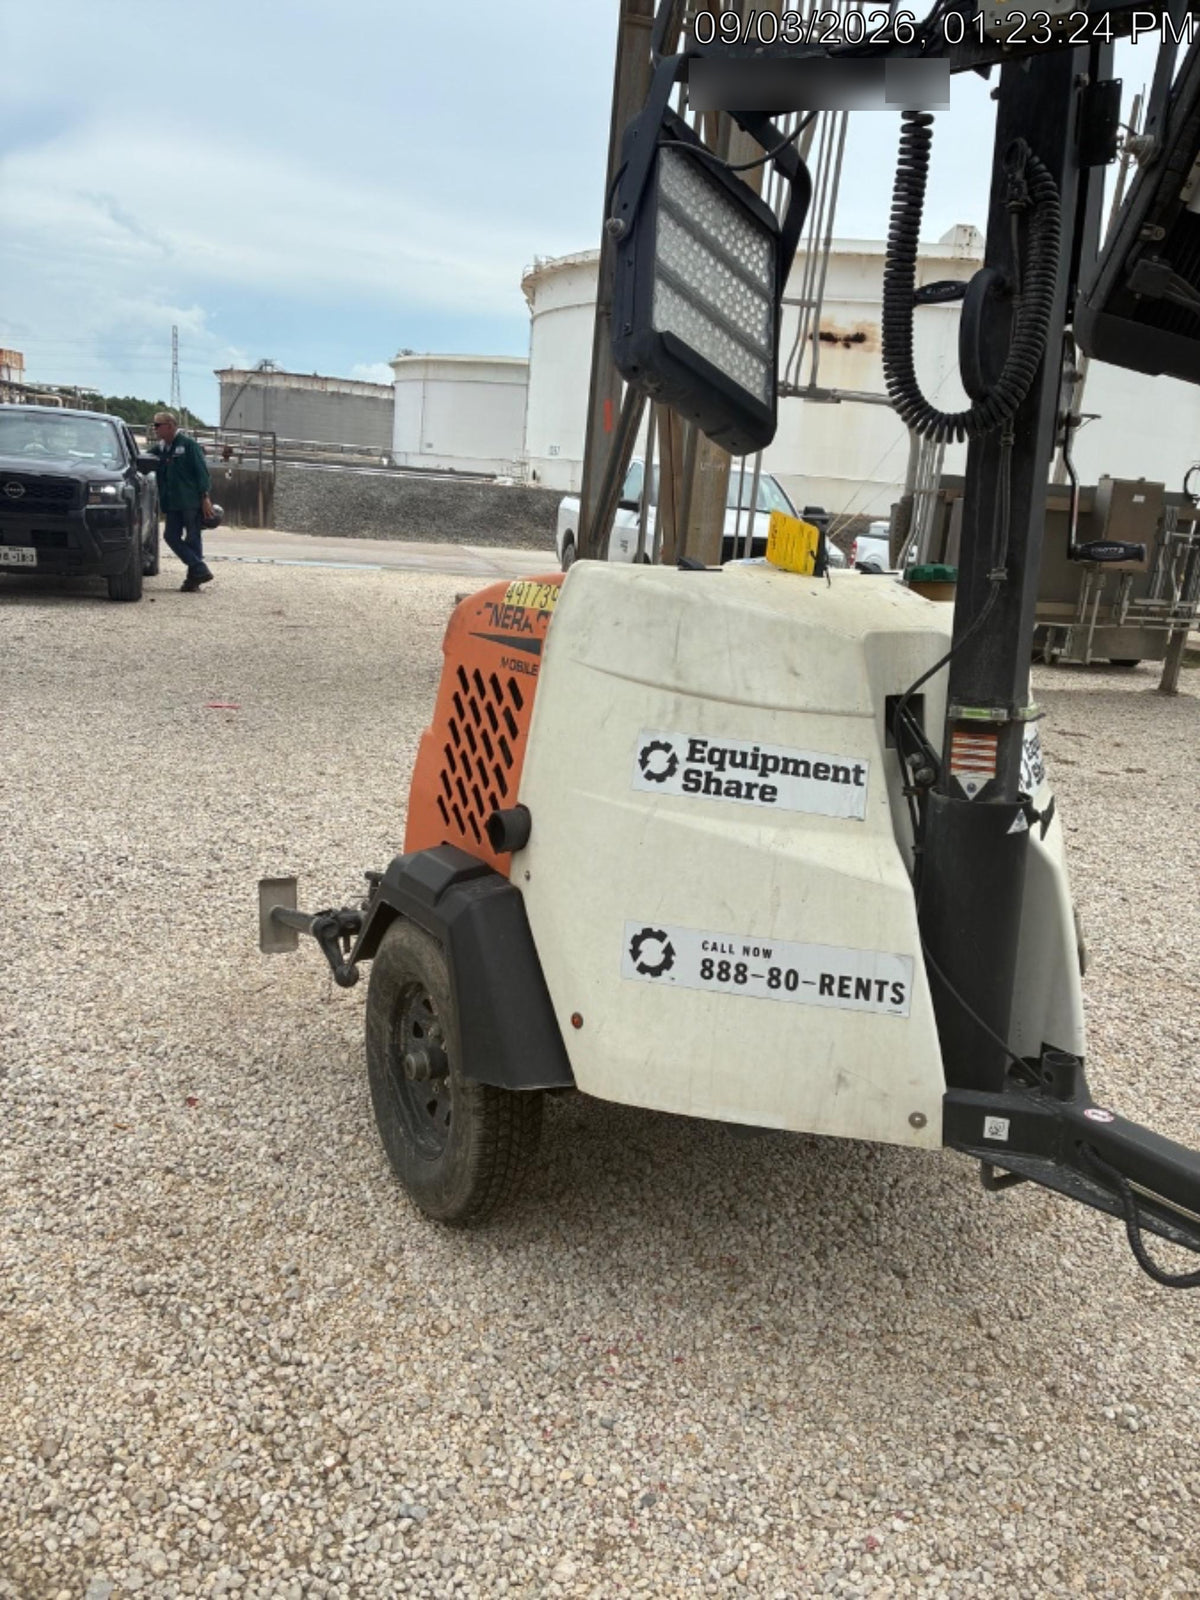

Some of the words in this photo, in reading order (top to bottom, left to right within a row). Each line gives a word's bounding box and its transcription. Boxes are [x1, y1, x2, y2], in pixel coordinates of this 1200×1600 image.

[686, 738, 865, 786] Equipment
[682, 768, 778, 803] Share
[701, 940, 736, 955] CALL
[742, 945, 774, 960] NOW
[699, 957, 907, 1005] 888-80-RENTS
